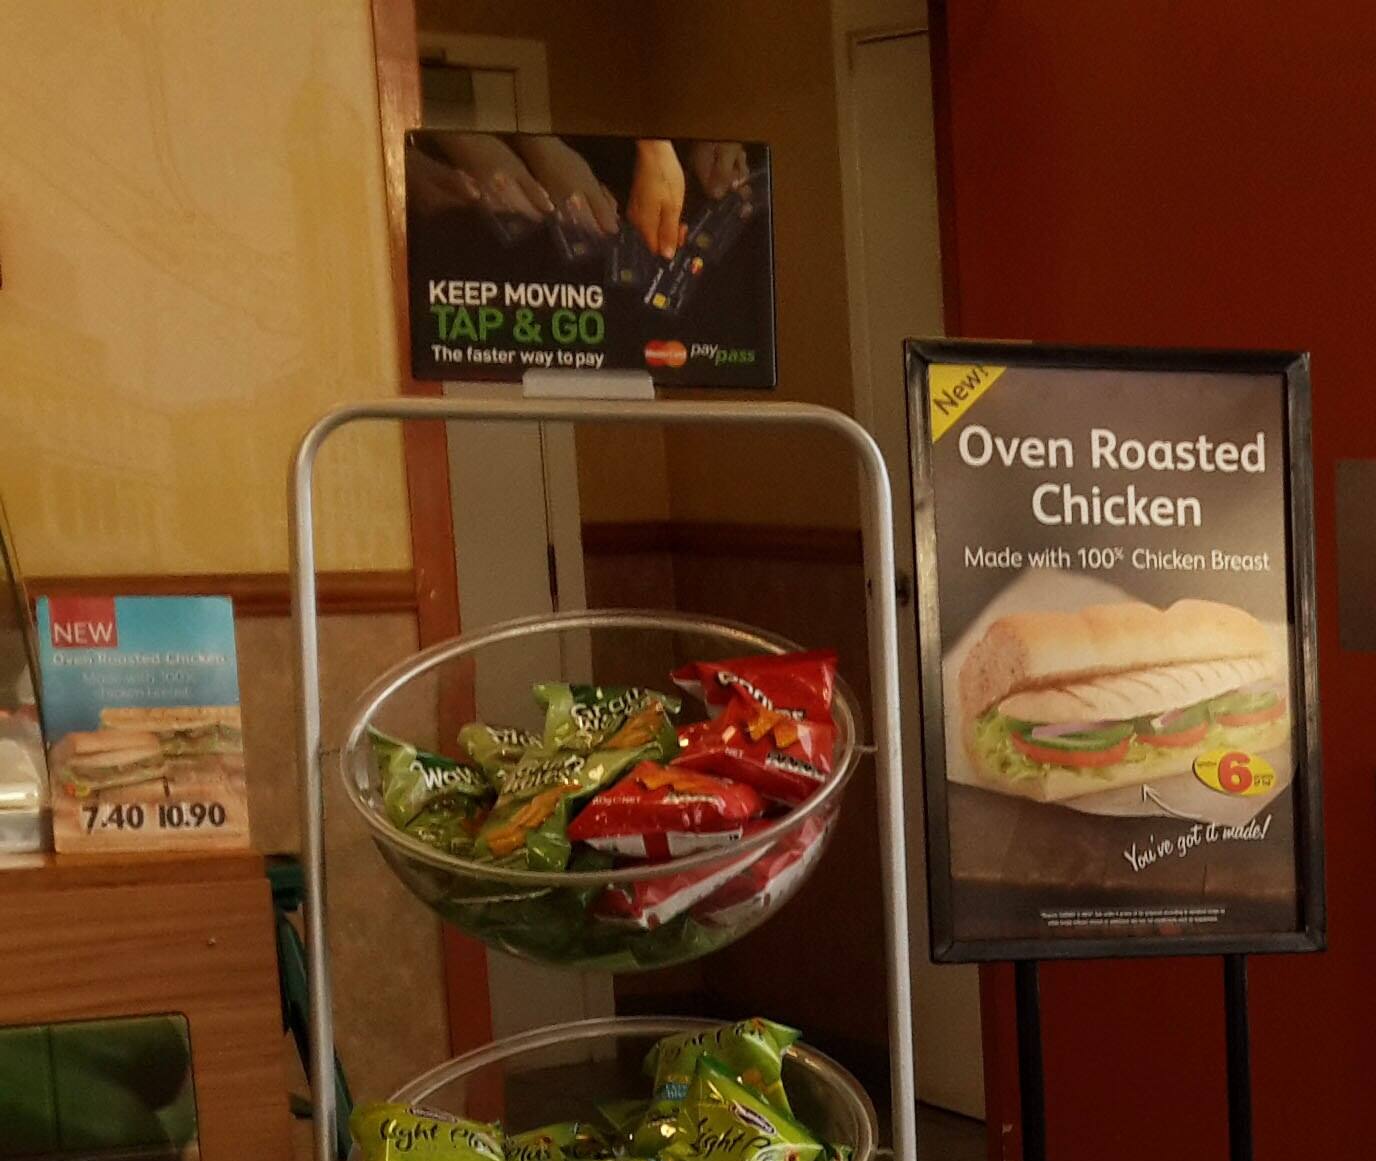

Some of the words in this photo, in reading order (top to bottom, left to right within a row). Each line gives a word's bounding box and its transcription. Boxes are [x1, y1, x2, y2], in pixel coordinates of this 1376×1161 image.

[429, 280, 498, 306] KEEP
[504, 282, 604, 309] MOVING
[431, 305, 504, 342] TAP
[512, 307, 543, 344] &
[551, 308, 605, 345] GO
[431, 344, 463, 363] The
[467, 345, 516, 364] faster
[519, 349, 554, 368] way
[557, 349, 574, 365] to
[576, 352, 604, 370] pay
[958, 424, 1074, 468] Oven
[1090, 428, 1266, 473] Roasted
[1032, 482, 1202, 528] Chicken
[964, 546, 1022, 568] Made
[1028, 546, 1071, 568] with
[1077, 546, 1124, 569] 100%
[1131, 548, 1206, 570] Chicken
[1211, 549, 1271, 571] Breast
[53, 621, 113, 644] NEW
[1218, 751, 1253, 793] 6
[82, 805, 144, 835] 7.40
[158, 802, 226, 829] 10.90
[1124, 833, 1174, 872] You've
[1177, 824, 1202, 857] got
[1205, 821, 1219, 843] it
[1222, 813, 1272, 842] made!
